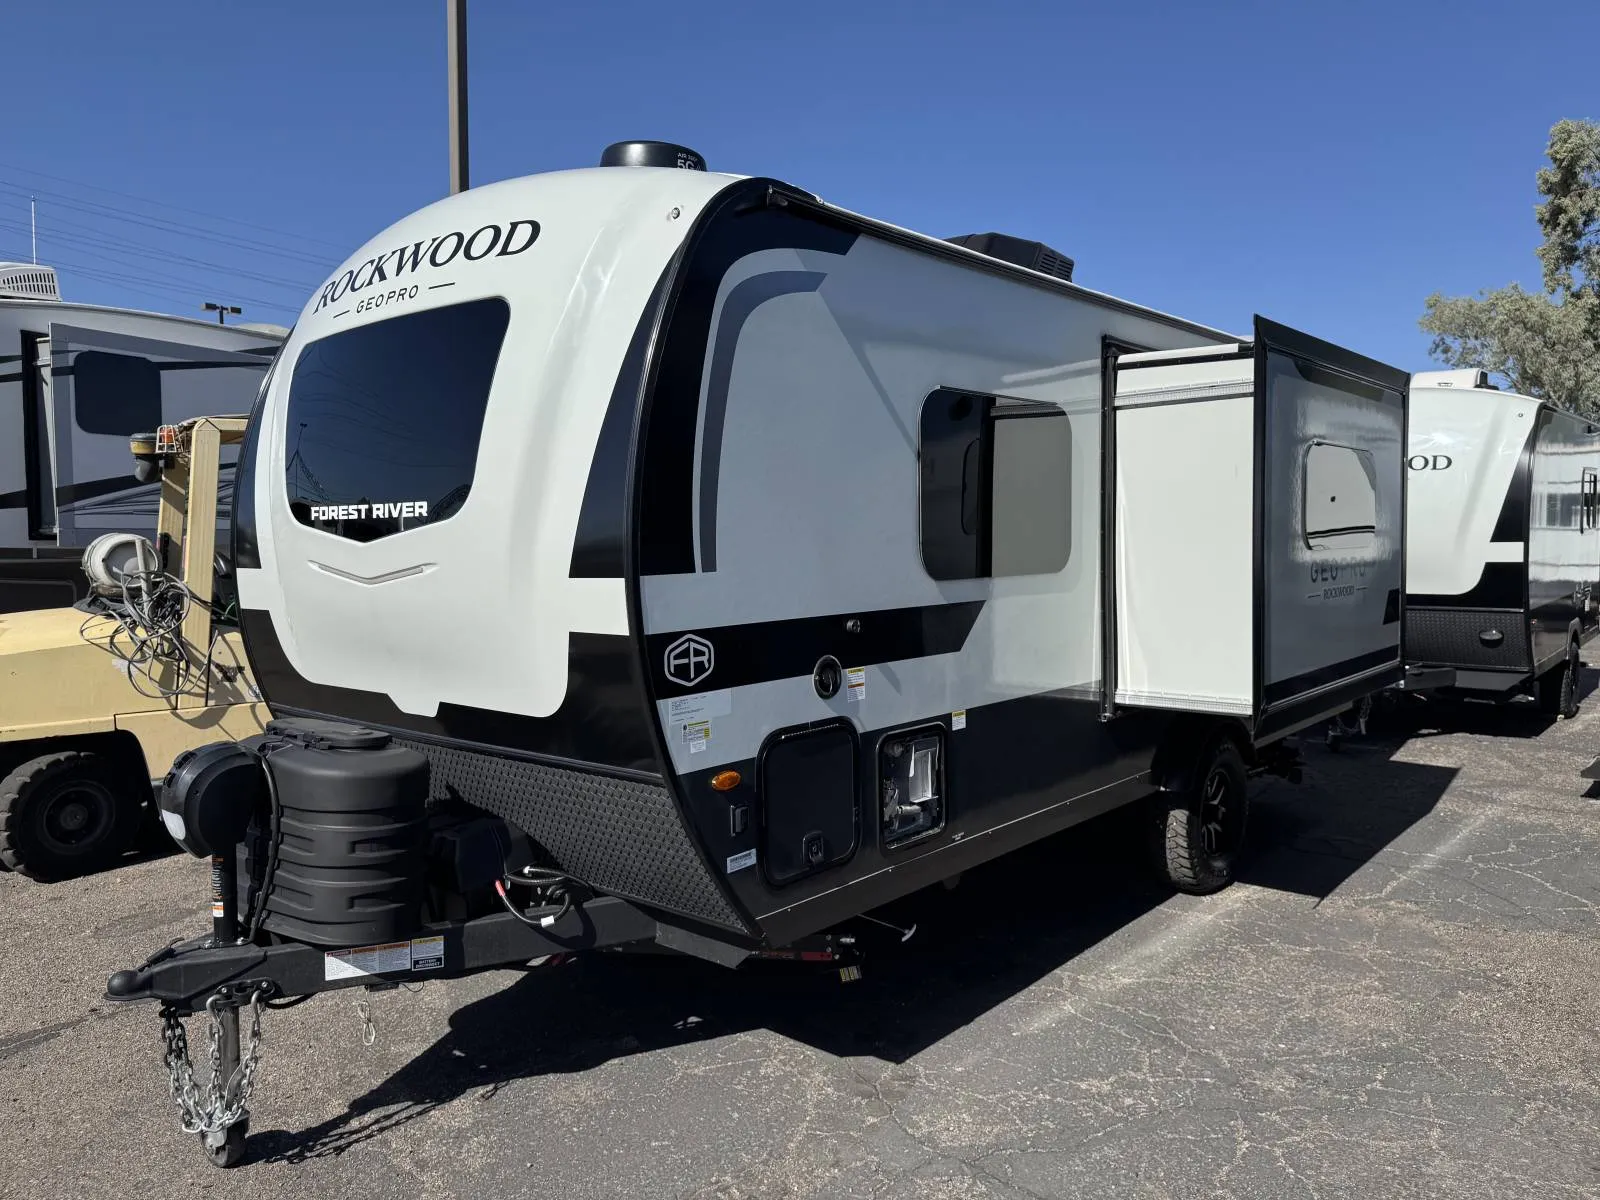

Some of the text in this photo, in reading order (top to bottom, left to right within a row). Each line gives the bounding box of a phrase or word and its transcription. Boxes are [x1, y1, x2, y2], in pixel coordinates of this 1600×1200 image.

[312, 219, 542, 316] ROCKWOOD
[355, 284, 419, 314] GEOPRO
[310, 500, 429, 521] FOREST RIVER
